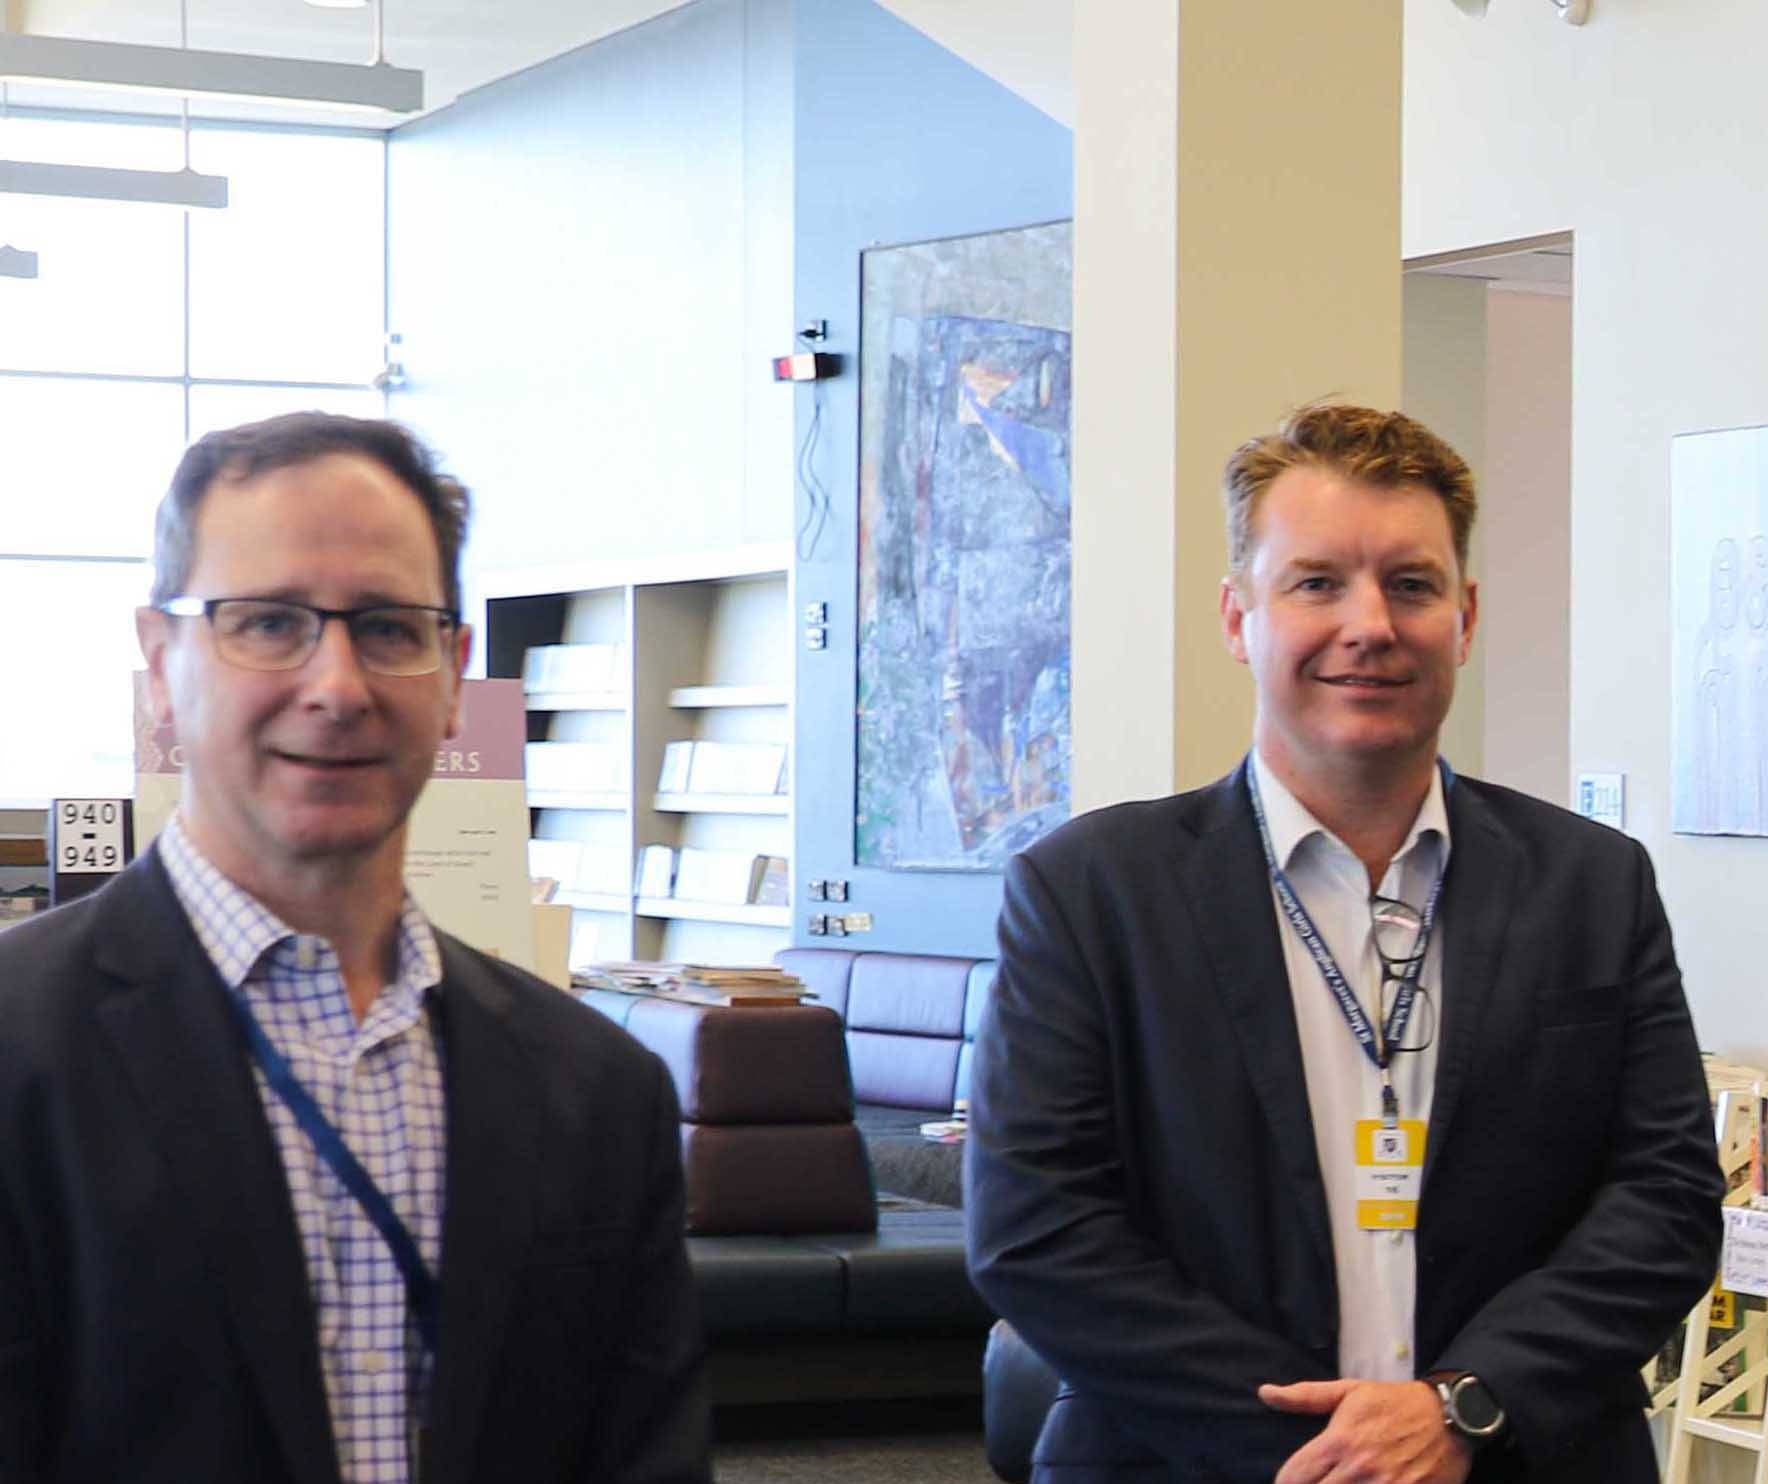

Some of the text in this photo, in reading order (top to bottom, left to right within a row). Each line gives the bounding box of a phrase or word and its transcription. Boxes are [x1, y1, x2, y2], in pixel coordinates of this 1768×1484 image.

[63, 803, 116, 824] 940
[65, 846, 118, 867] 949
[1301, 935, 1335, 981] Anglican
[1326, 979, 1367, 1034] Margaret's
